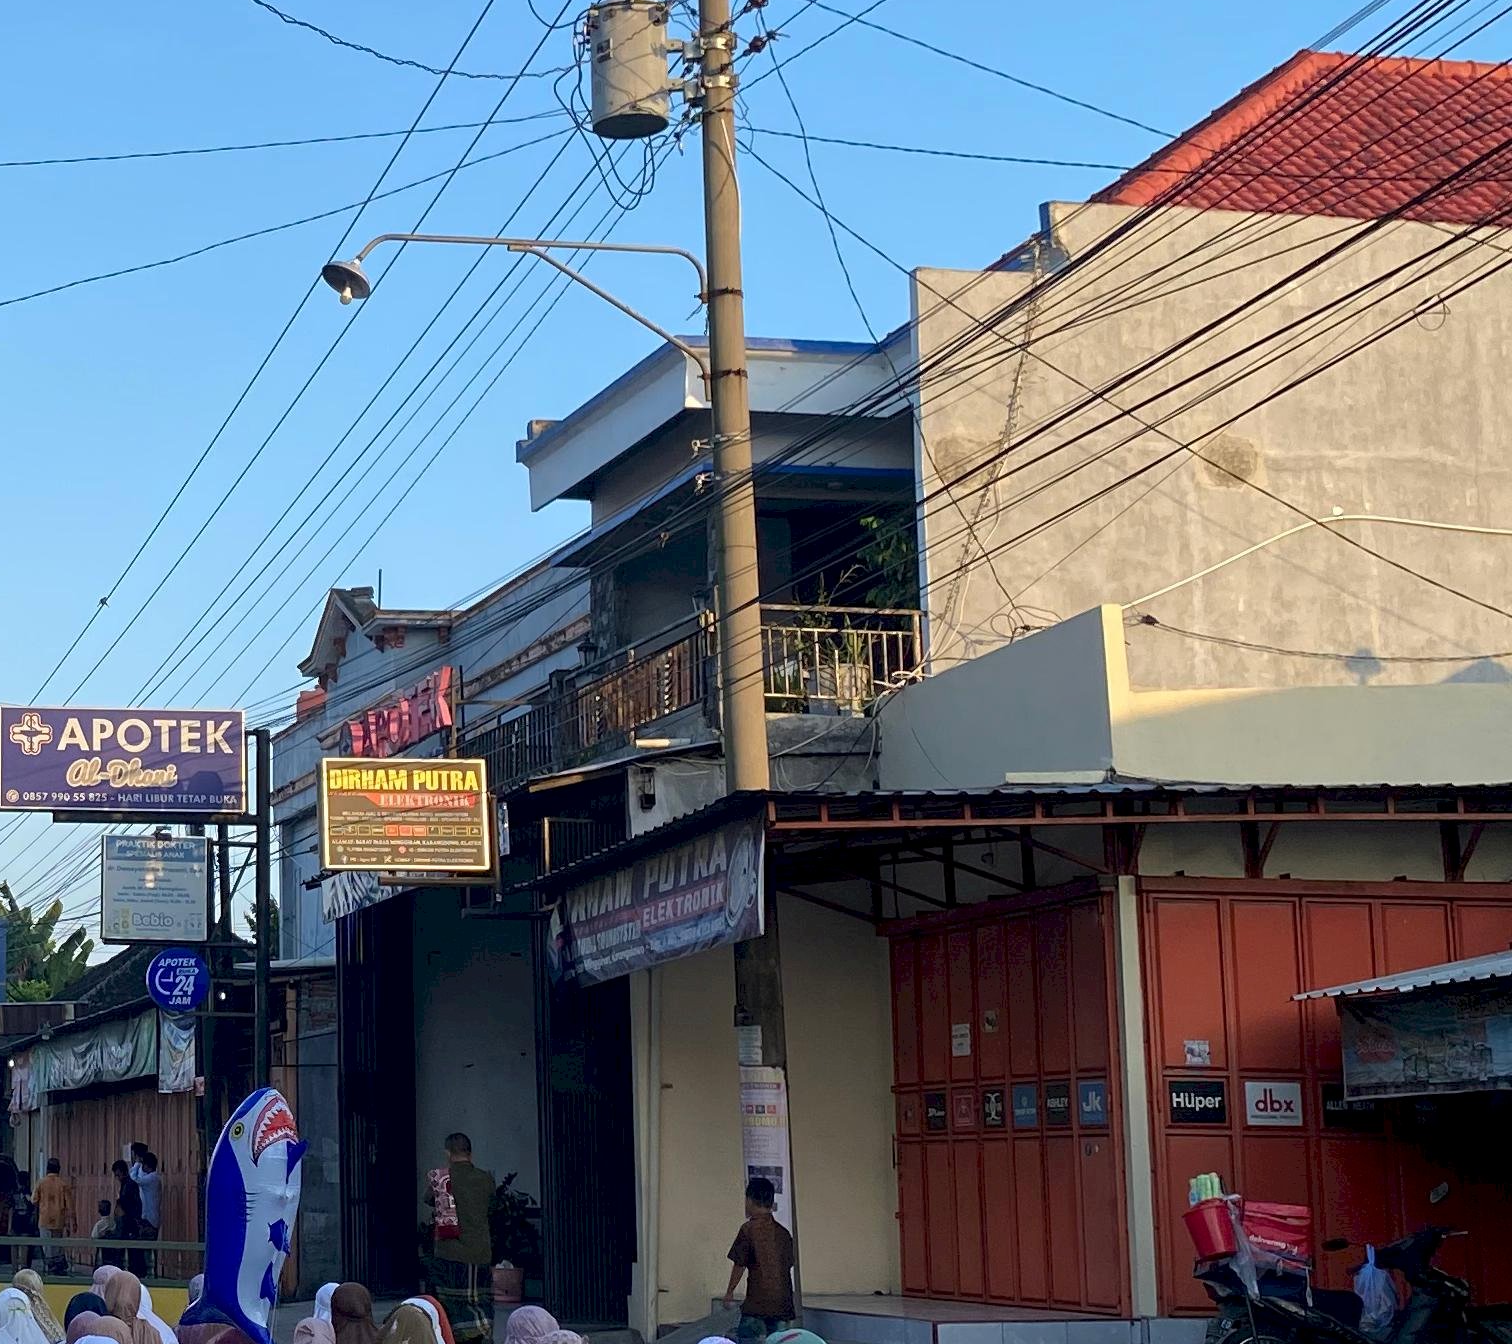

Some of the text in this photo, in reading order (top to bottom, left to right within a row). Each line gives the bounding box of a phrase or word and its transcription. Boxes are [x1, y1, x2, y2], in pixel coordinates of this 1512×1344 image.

[57, 717, 233, 754] APOTEK
[67, 757, 177, 788] Al-Dhani
[329, 769, 478, 791] DIRHAM PUTRA
[23, 792, 48, 801] 0857
[51, 792, 70, 802] 990
[73, 792, 85, 801] 55
[88, 792, 107, 802] 825
[118, 792, 143, 803] HARI
[146, 793, 174, 803] LIBUR
[177, 794, 207, 804] TETAP
[209, 795, 237, 804] BUKA
[380, 794, 470, 807] ELEKTRONIK
[116, 839, 196, 850] PRAKTIK DOKTER
[644, 832, 727, 899] PUTRA
[643, 882, 724, 928] ELEKTRONIK
[158, 958, 196, 967] APOTEK
[172, 975, 195, 996] 24
[169, 996, 191, 1005] JAM
[1255, 1089, 1294, 1114] dbx
